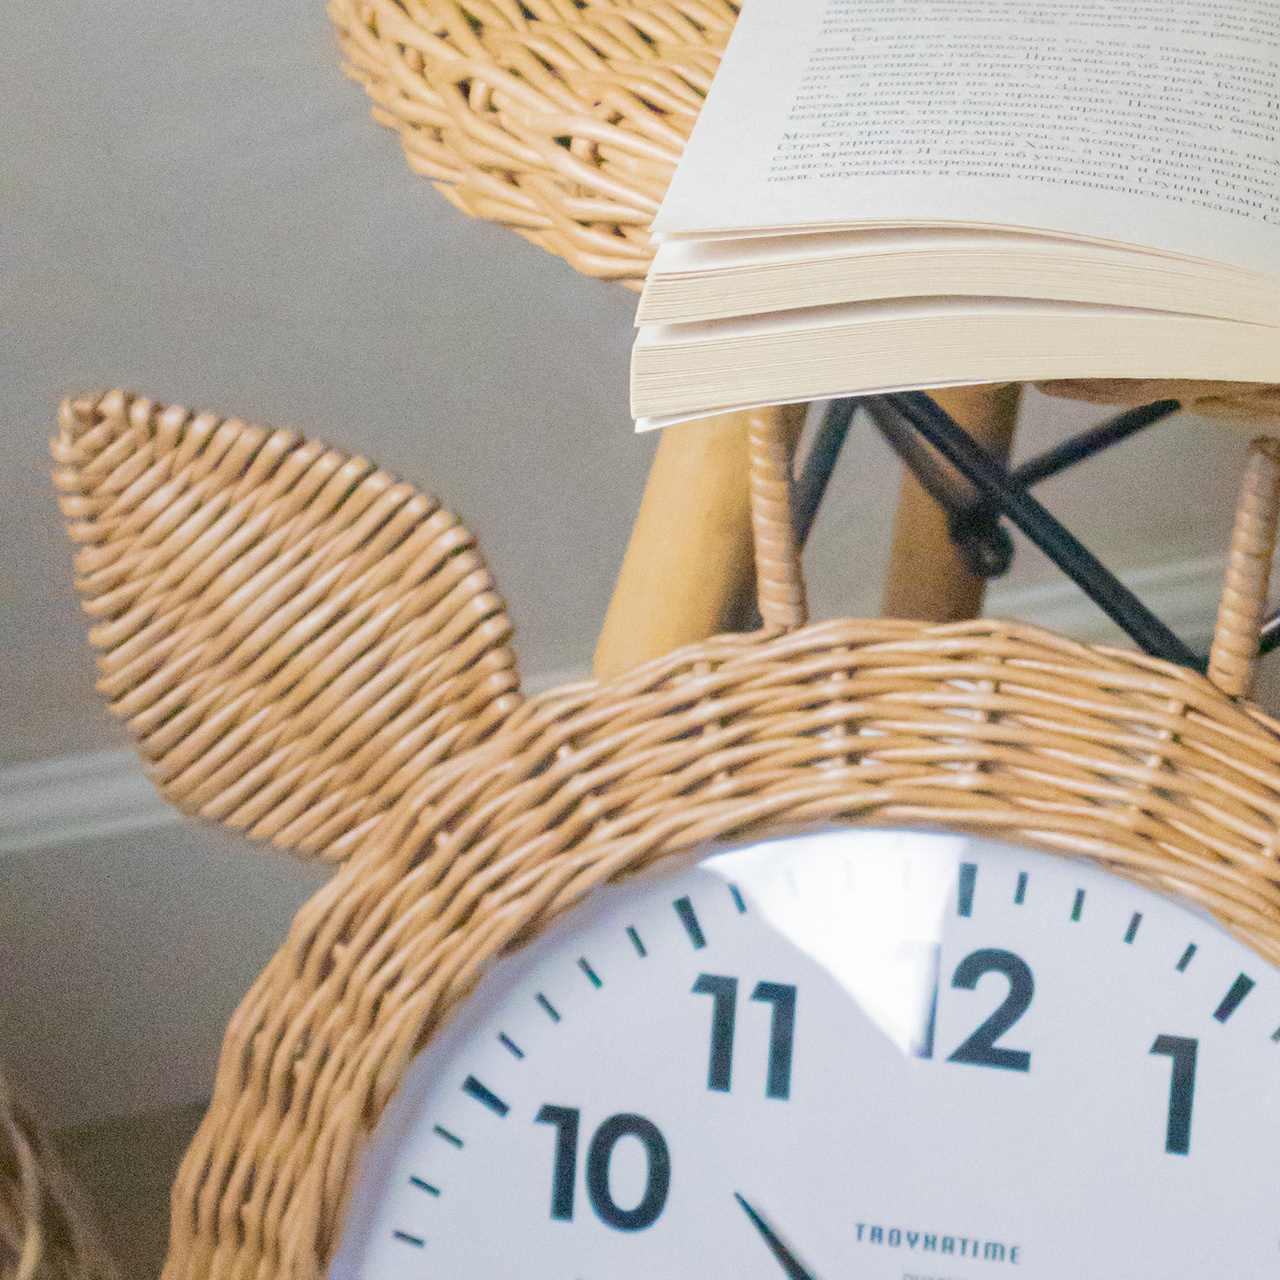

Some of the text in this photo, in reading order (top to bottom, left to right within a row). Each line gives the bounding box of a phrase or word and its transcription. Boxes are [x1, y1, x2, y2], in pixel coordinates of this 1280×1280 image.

[692, 973, 797, 1100] 11
[1150, 1034, 1199, 1156] 1
[535, 1103, 672, 1233] 10
